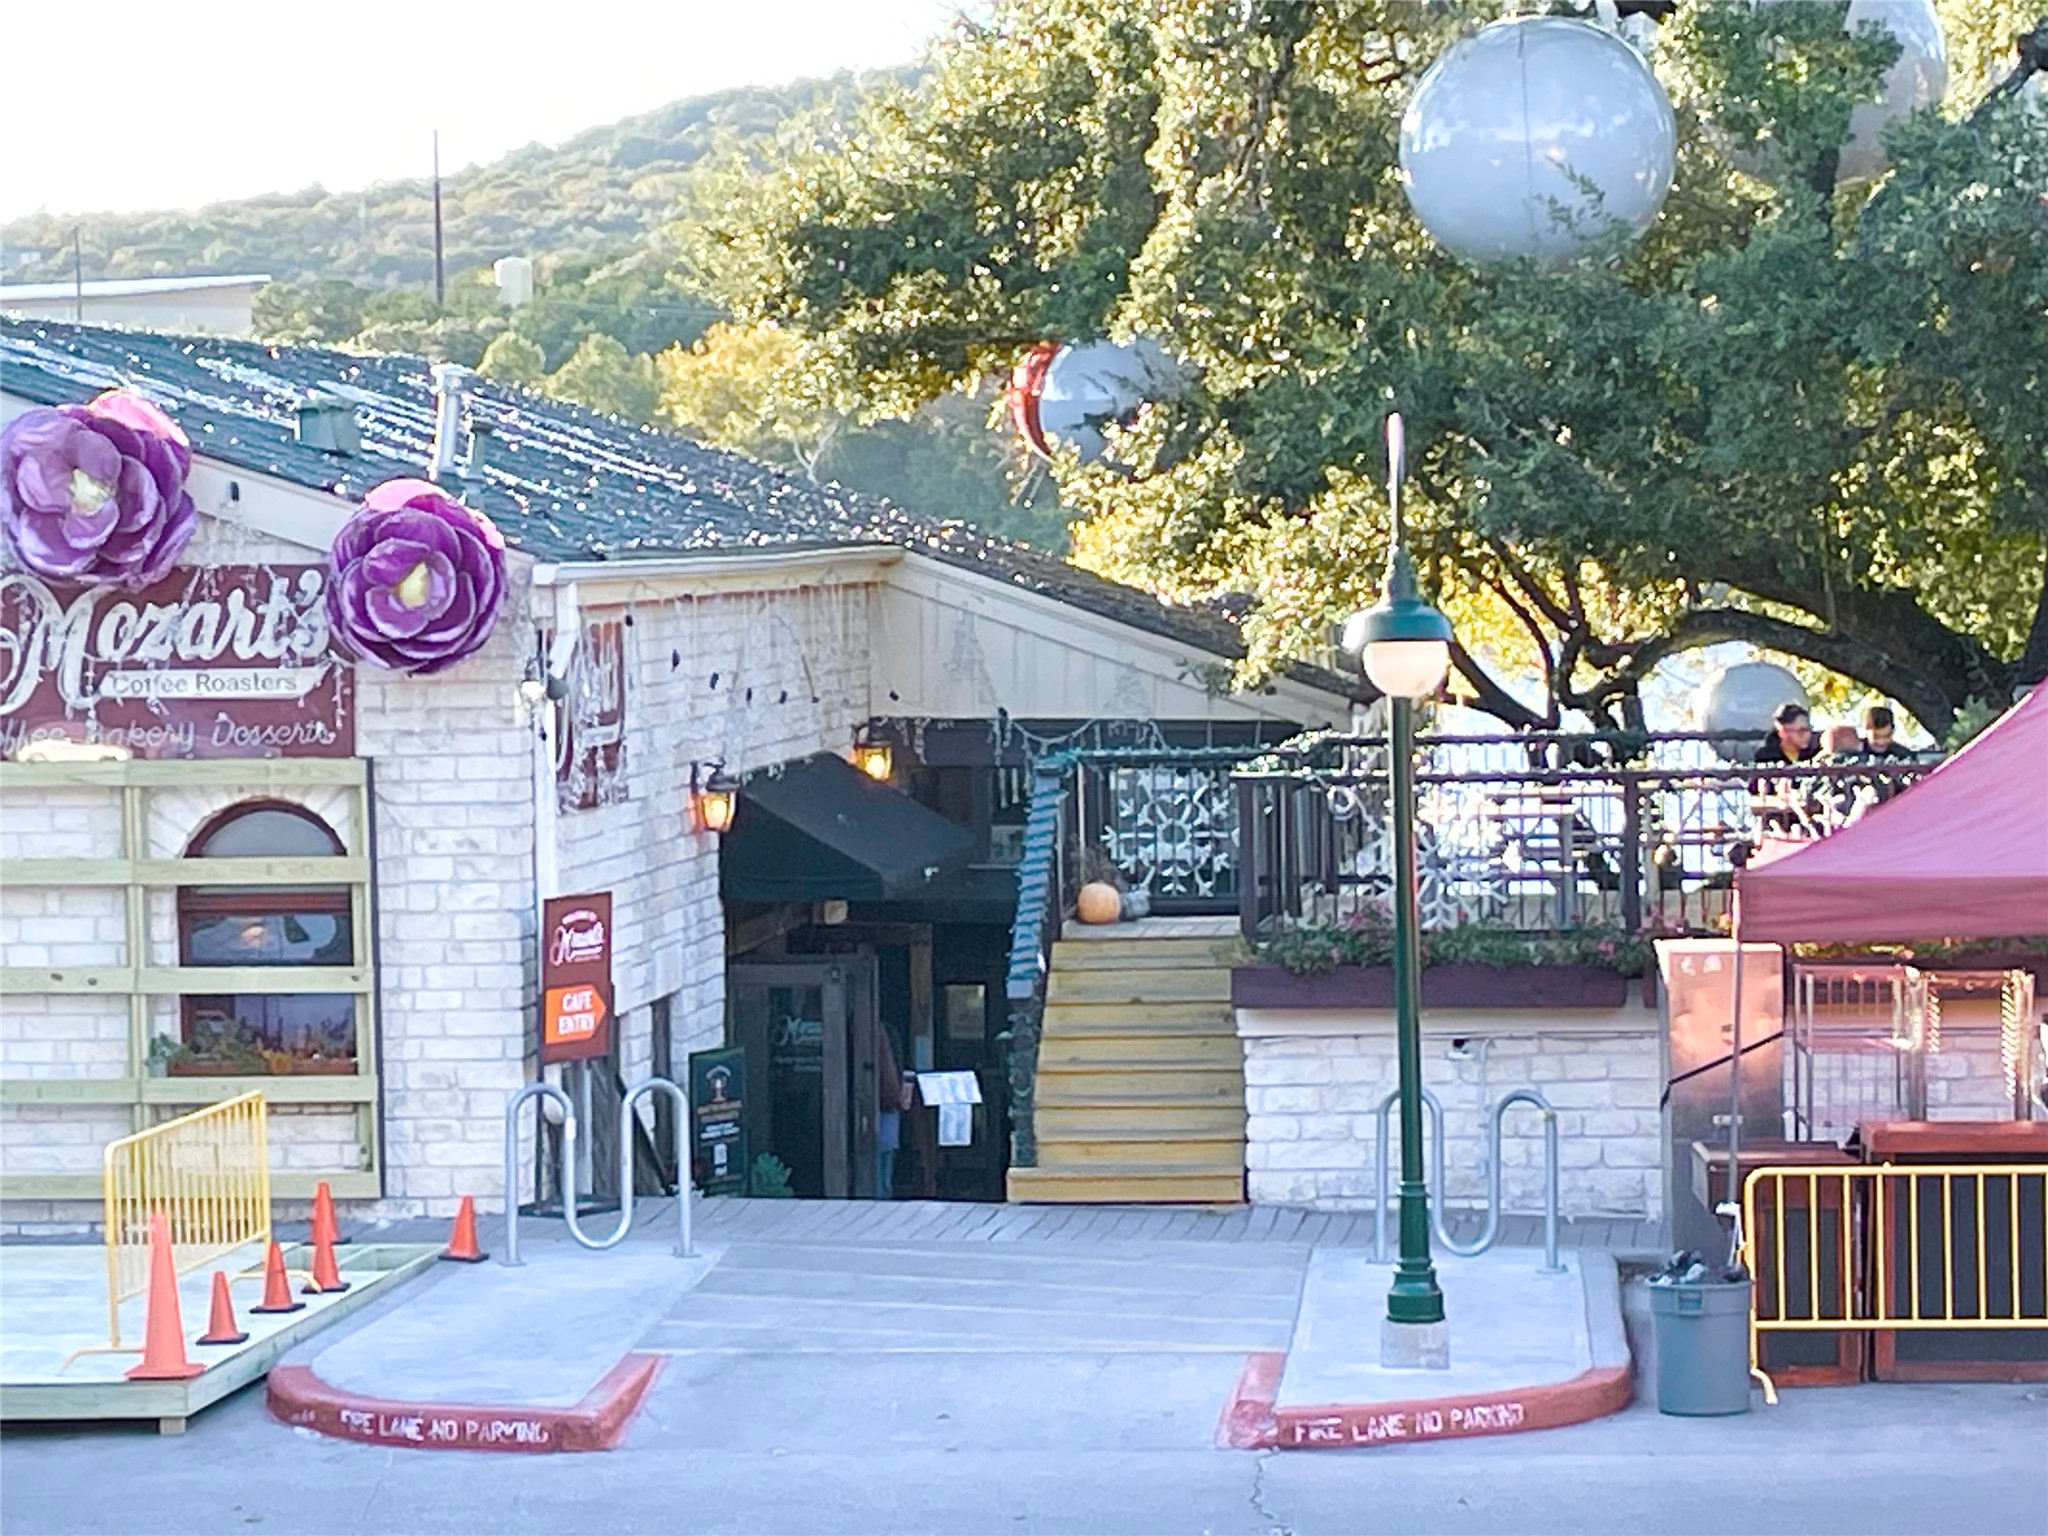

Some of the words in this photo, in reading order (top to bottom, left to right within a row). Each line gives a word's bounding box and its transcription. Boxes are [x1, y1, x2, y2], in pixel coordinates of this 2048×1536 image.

[0, 570, 331, 714] Mozart's
[112, 673, 188, 695] Coffee
[196, 671, 298, 694] Roasters
[211, 712, 336, 747] Desserts
[562, 990, 593, 1012] CAFE
[427, 1418, 458, 1441] NO
[1352, 1411, 1407, 1441] LANE
[1415, 1410, 1442, 1434] NO
